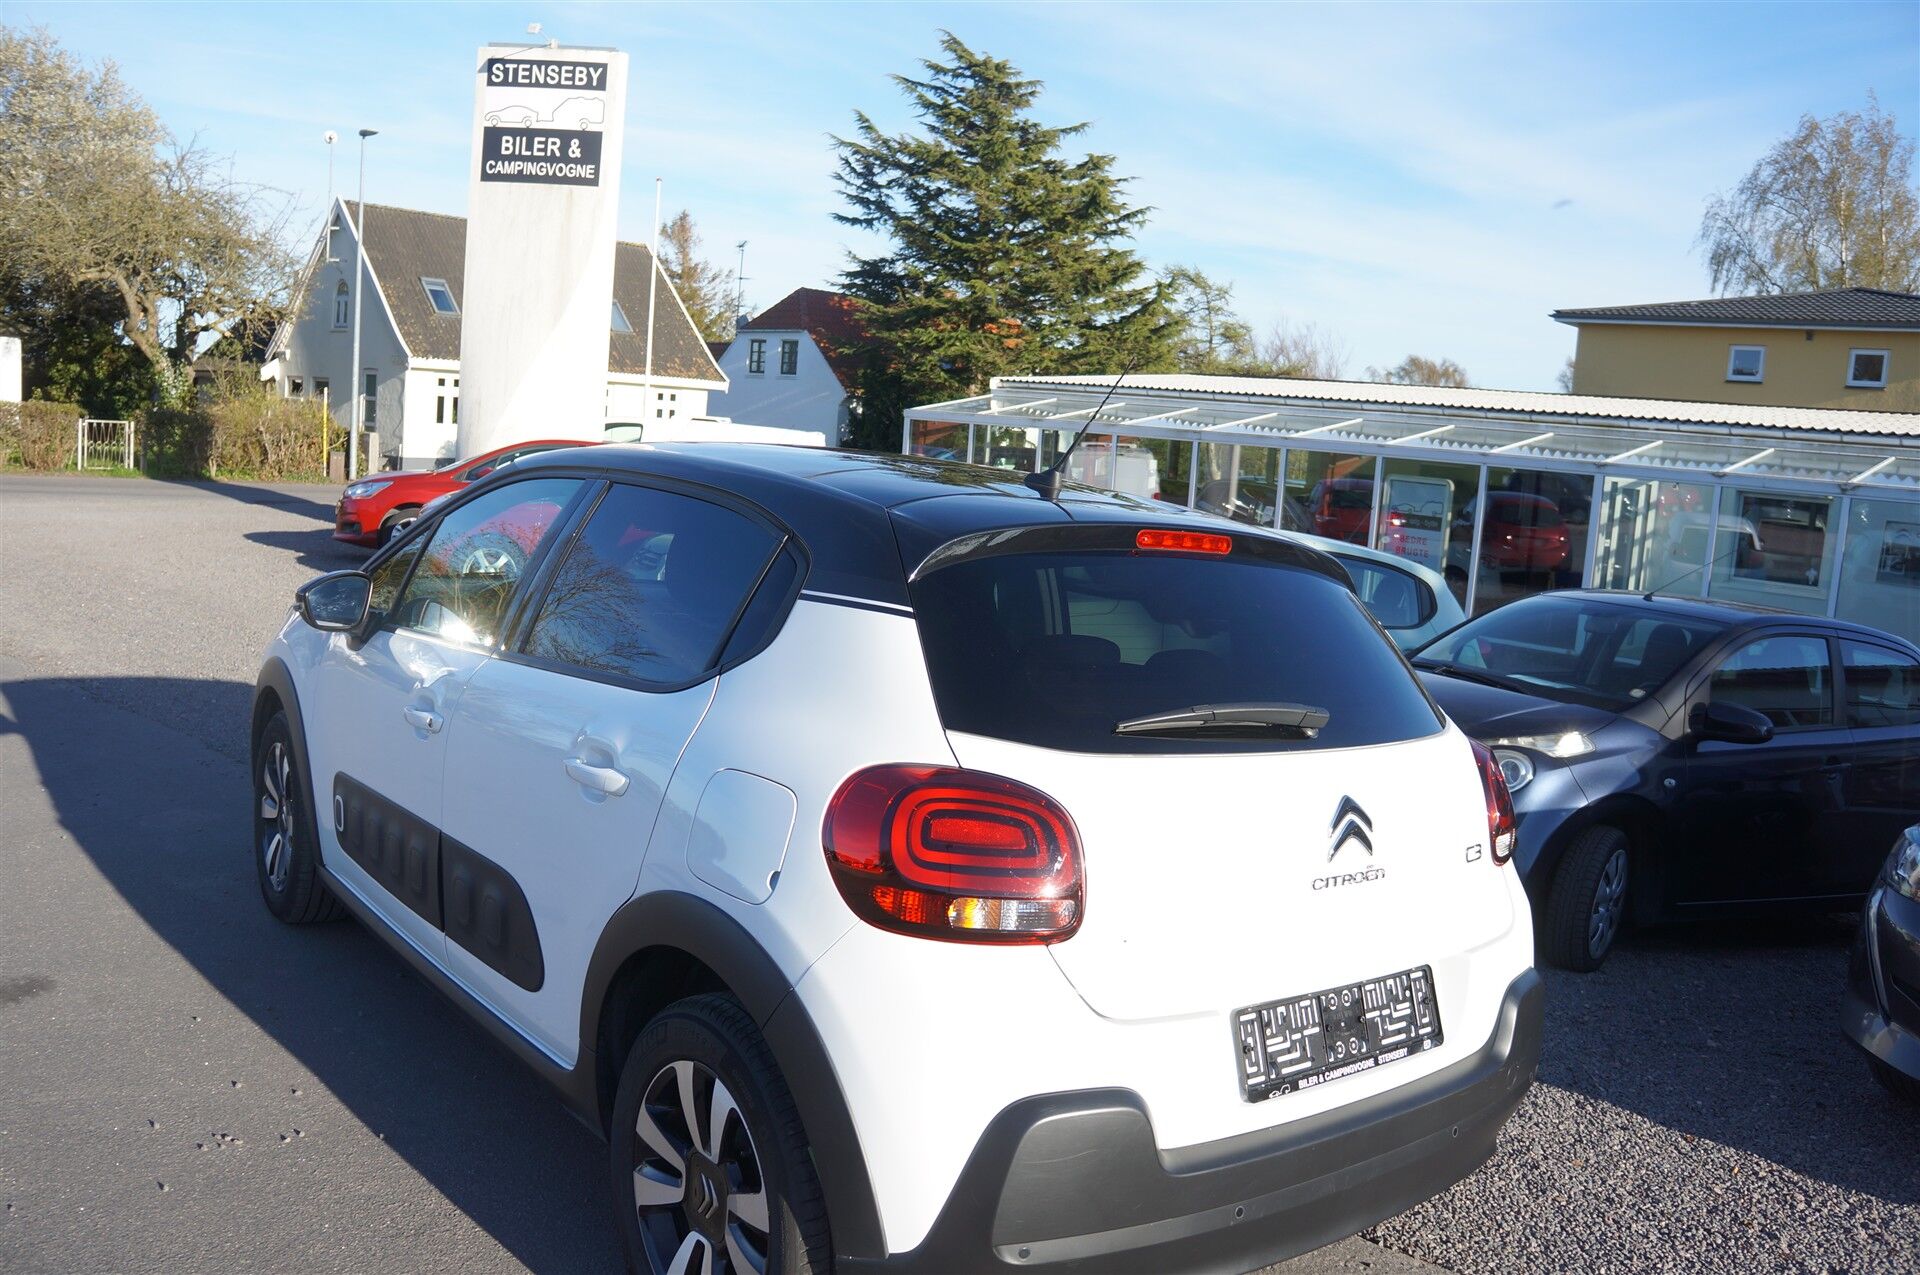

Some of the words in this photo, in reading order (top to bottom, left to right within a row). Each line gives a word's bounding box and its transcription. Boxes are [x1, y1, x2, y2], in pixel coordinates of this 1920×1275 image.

[491, 63, 603, 87] STENSEBY
[500, 135, 561, 157] BILER
[568, 138, 581, 158] &
[486, 160, 595, 178] CAMPINGVOGNE
[1465, 843, 1482, 863] C3
[1298, 1075, 1318, 1089] BILER
[1318, 1073, 1325, 1083] &
[1325, 1058, 1375, 1080] CAMPINGVOGNE
[1377, 1047, 1408, 1065] STENSEBY
